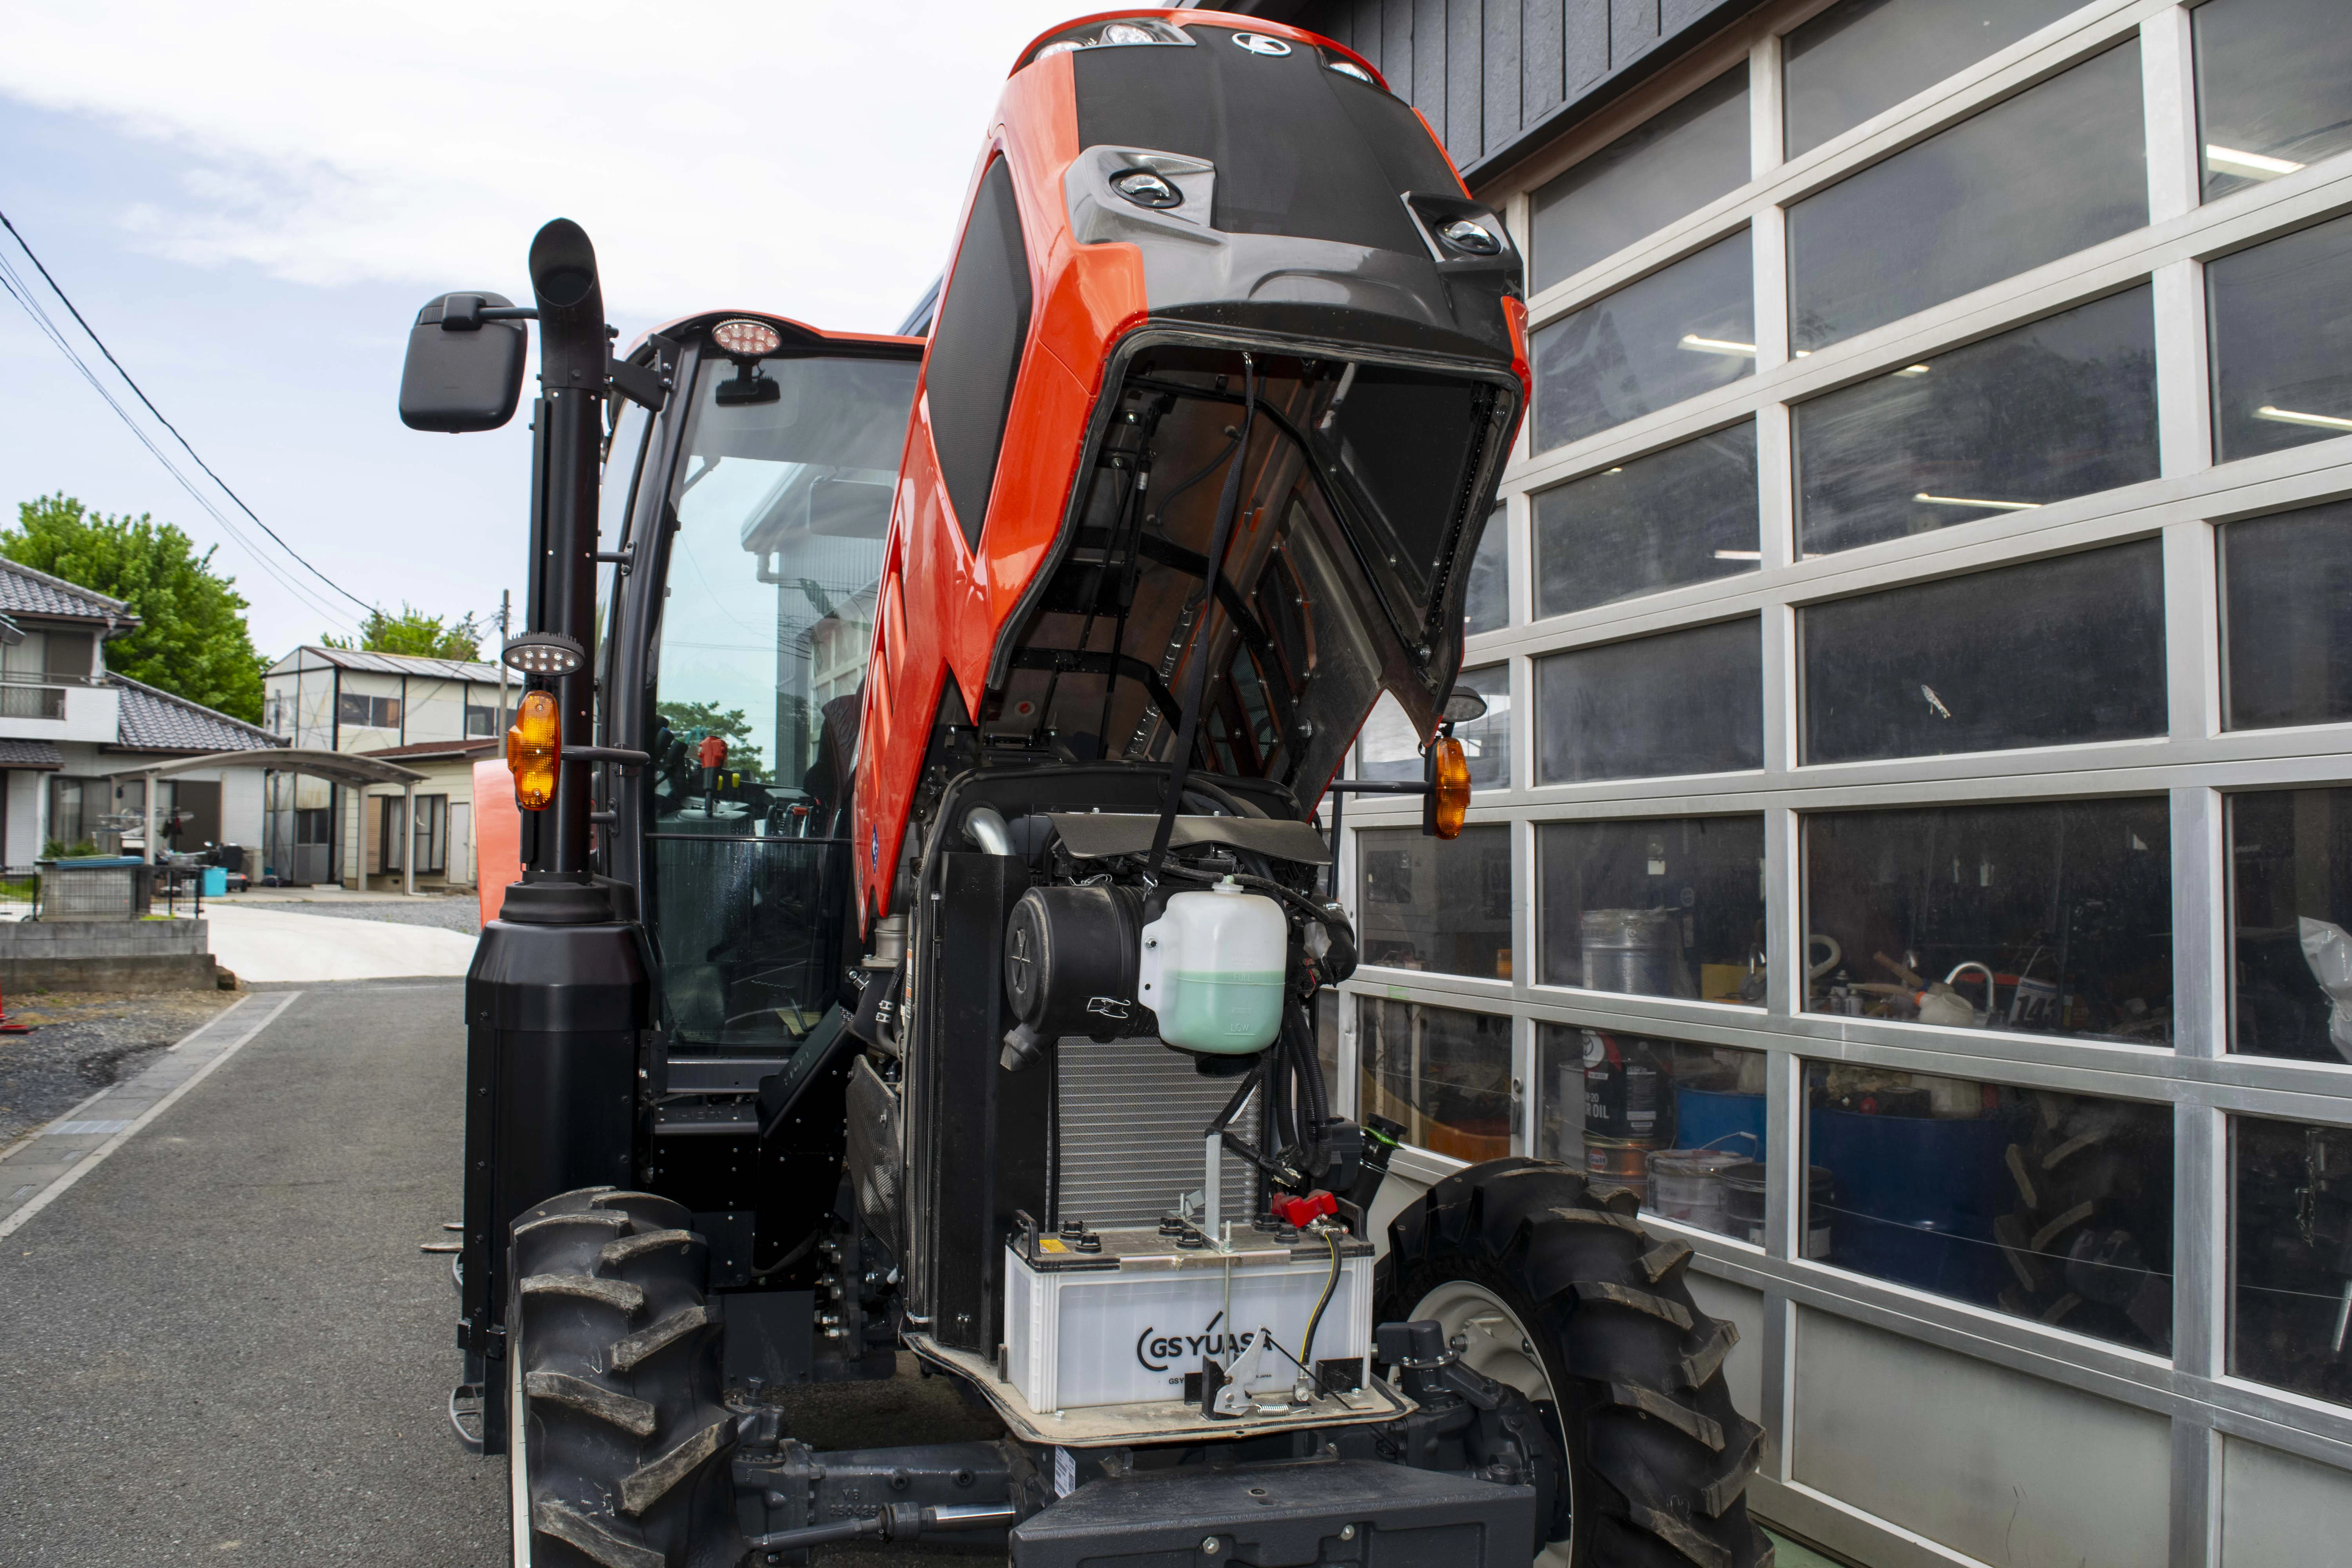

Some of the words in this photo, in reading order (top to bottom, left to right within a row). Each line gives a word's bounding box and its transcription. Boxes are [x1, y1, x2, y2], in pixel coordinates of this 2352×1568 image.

[1234, 973, 1252, 982] FULL
[1230, 1024, 1249, 1032] LOW
[677, 1110, 722, 1120] HOT
[1593, 1104, 1610, 1119] OIL
[1590, 1154, 1606, 1163] Gulf
[1150, 1337, 1183, 1358] GS
